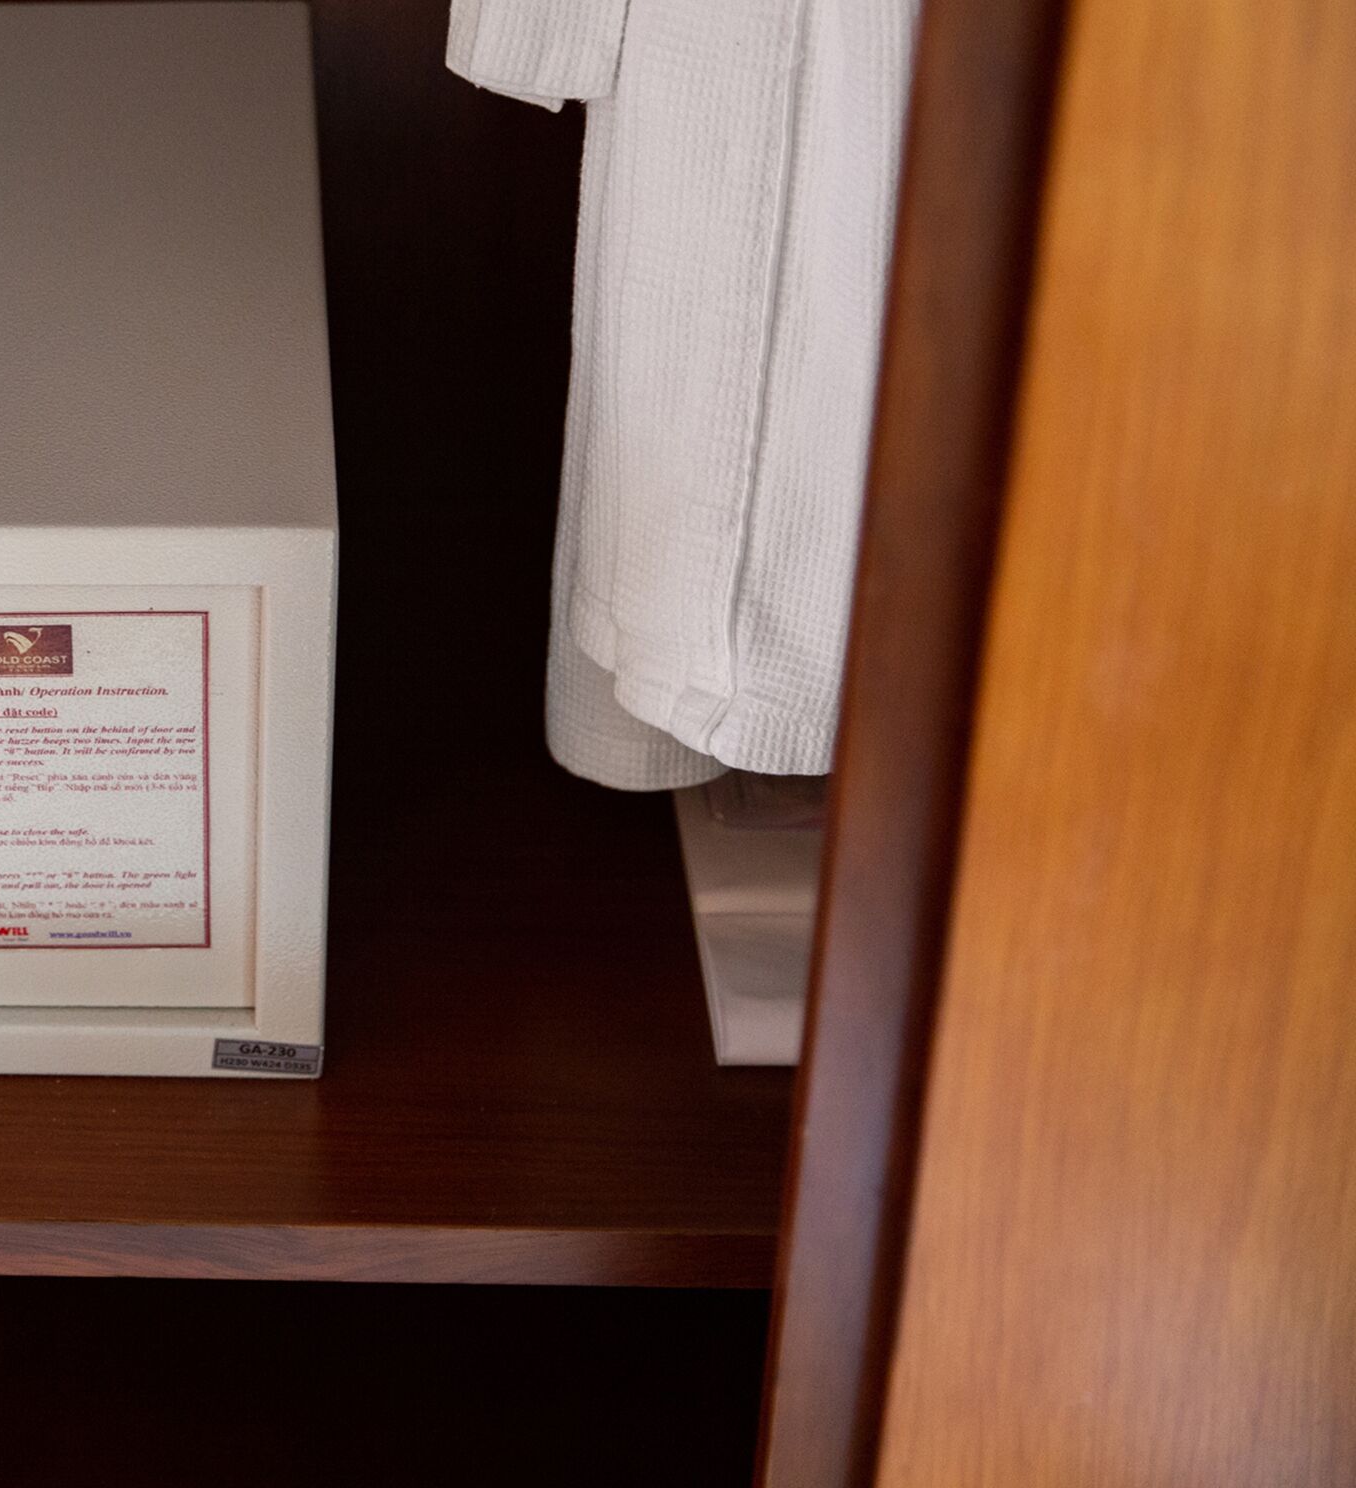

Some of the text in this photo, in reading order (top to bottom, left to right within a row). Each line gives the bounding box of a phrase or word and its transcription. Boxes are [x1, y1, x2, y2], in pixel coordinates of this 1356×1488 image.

[24, 655, 67, 664] COAST
[29, 686, 92, 698] Operation
[96, 686, 169, 696] Instruction.
[3, 708, 22, 718] đặt
[25, 708, 58, 718] code)
[5, 726, 28, 734] reset
[138, 726, 148, 735] of
[239, 1044, 296, 1058] GA-230
